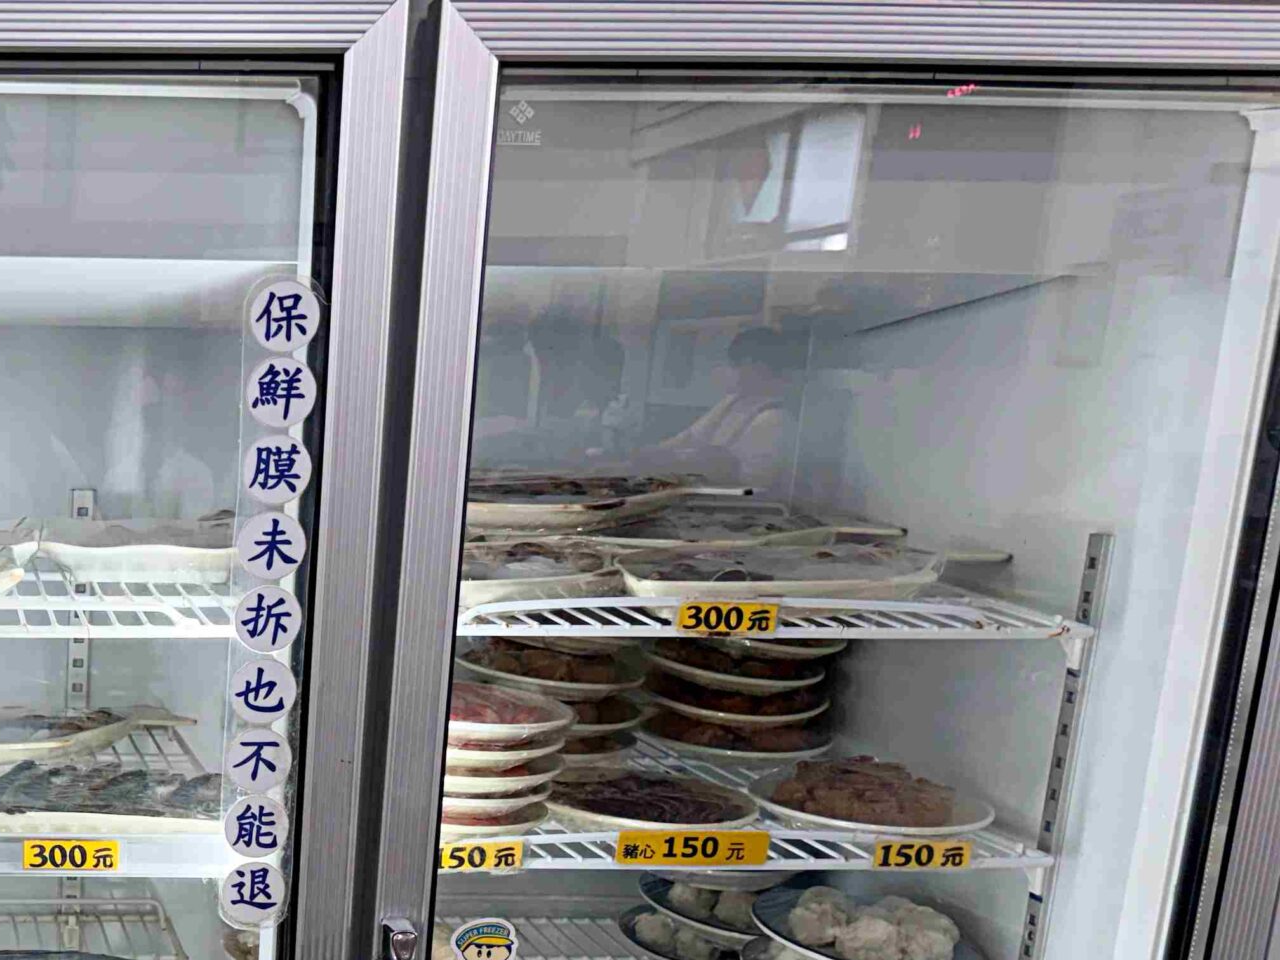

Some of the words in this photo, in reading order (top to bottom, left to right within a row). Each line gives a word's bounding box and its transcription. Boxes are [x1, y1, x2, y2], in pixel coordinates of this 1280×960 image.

[230, 291, 308, 910] 保鮮膜未拆也不能退
